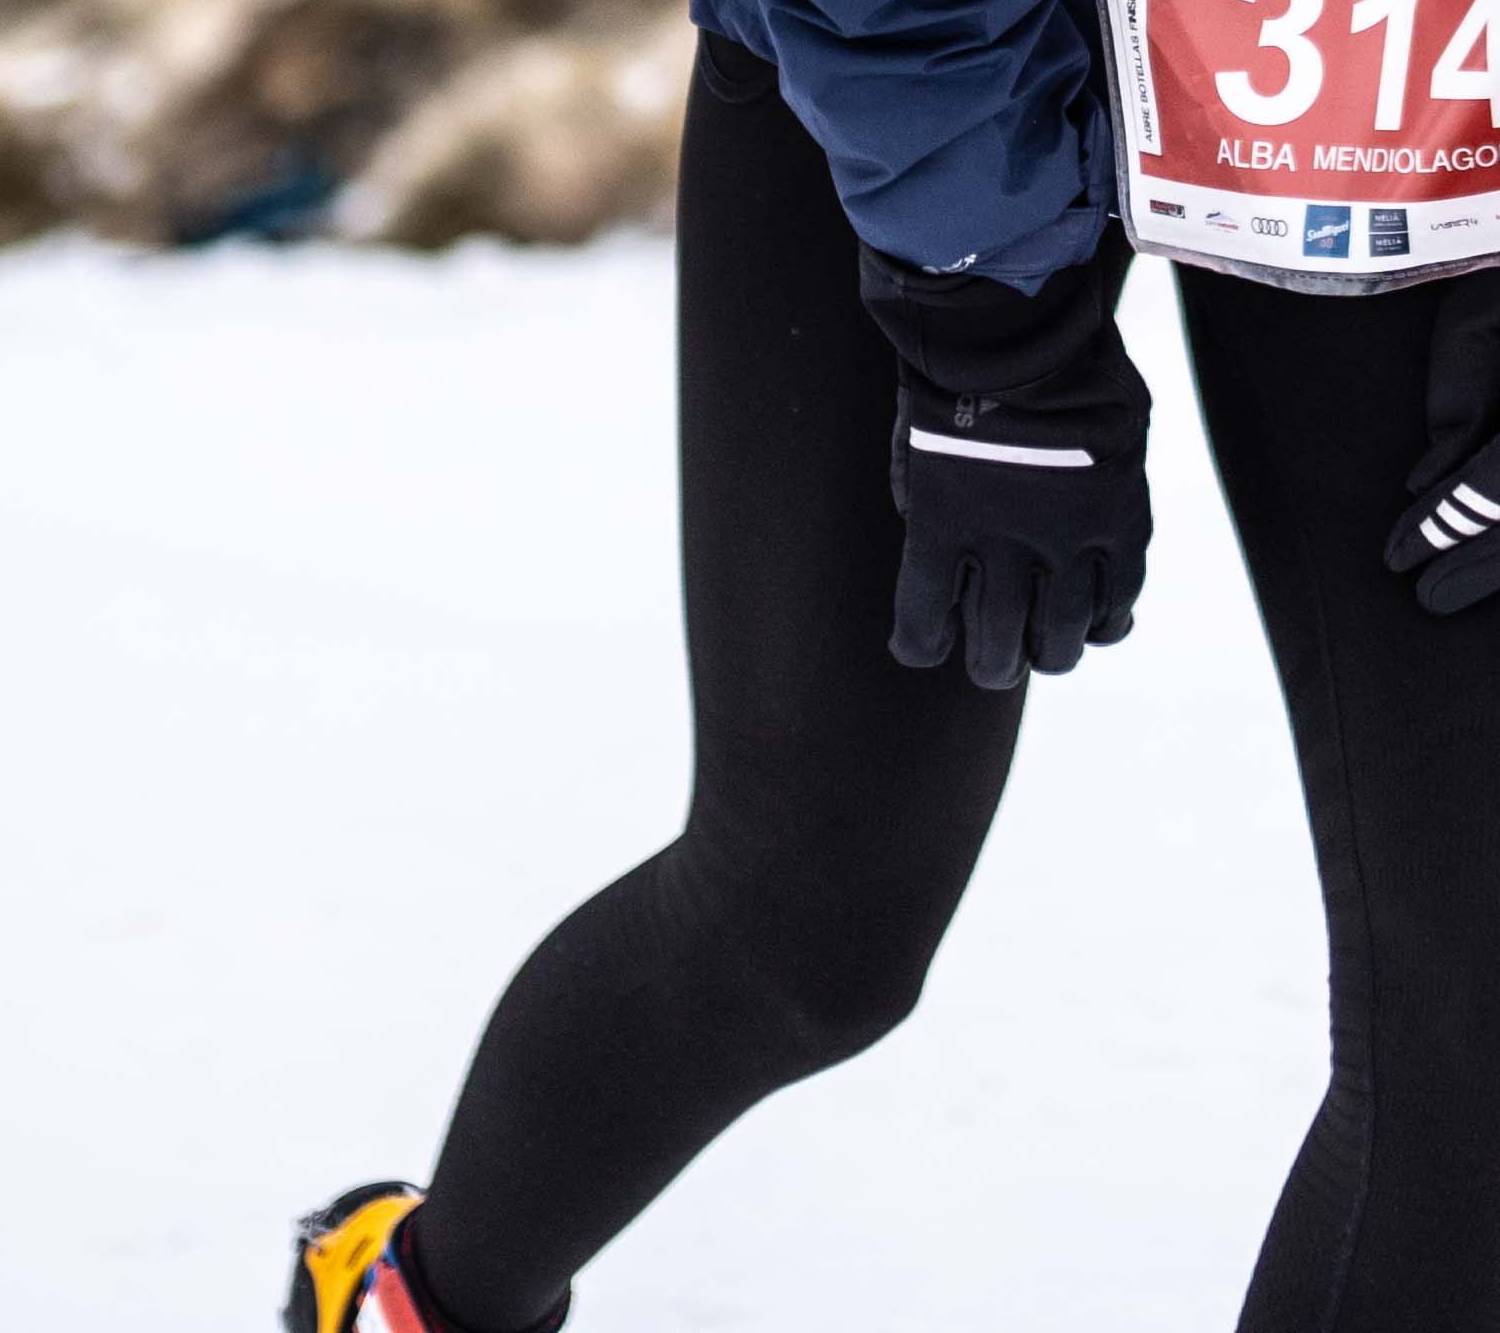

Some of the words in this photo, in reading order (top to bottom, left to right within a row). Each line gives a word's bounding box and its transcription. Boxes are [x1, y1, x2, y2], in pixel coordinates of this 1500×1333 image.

[1131, 35, 1148, 103] BOTELLAS
[1141, 108, 1153, 143] ABRE
[1216, 138, 1296, 173] ALBA
